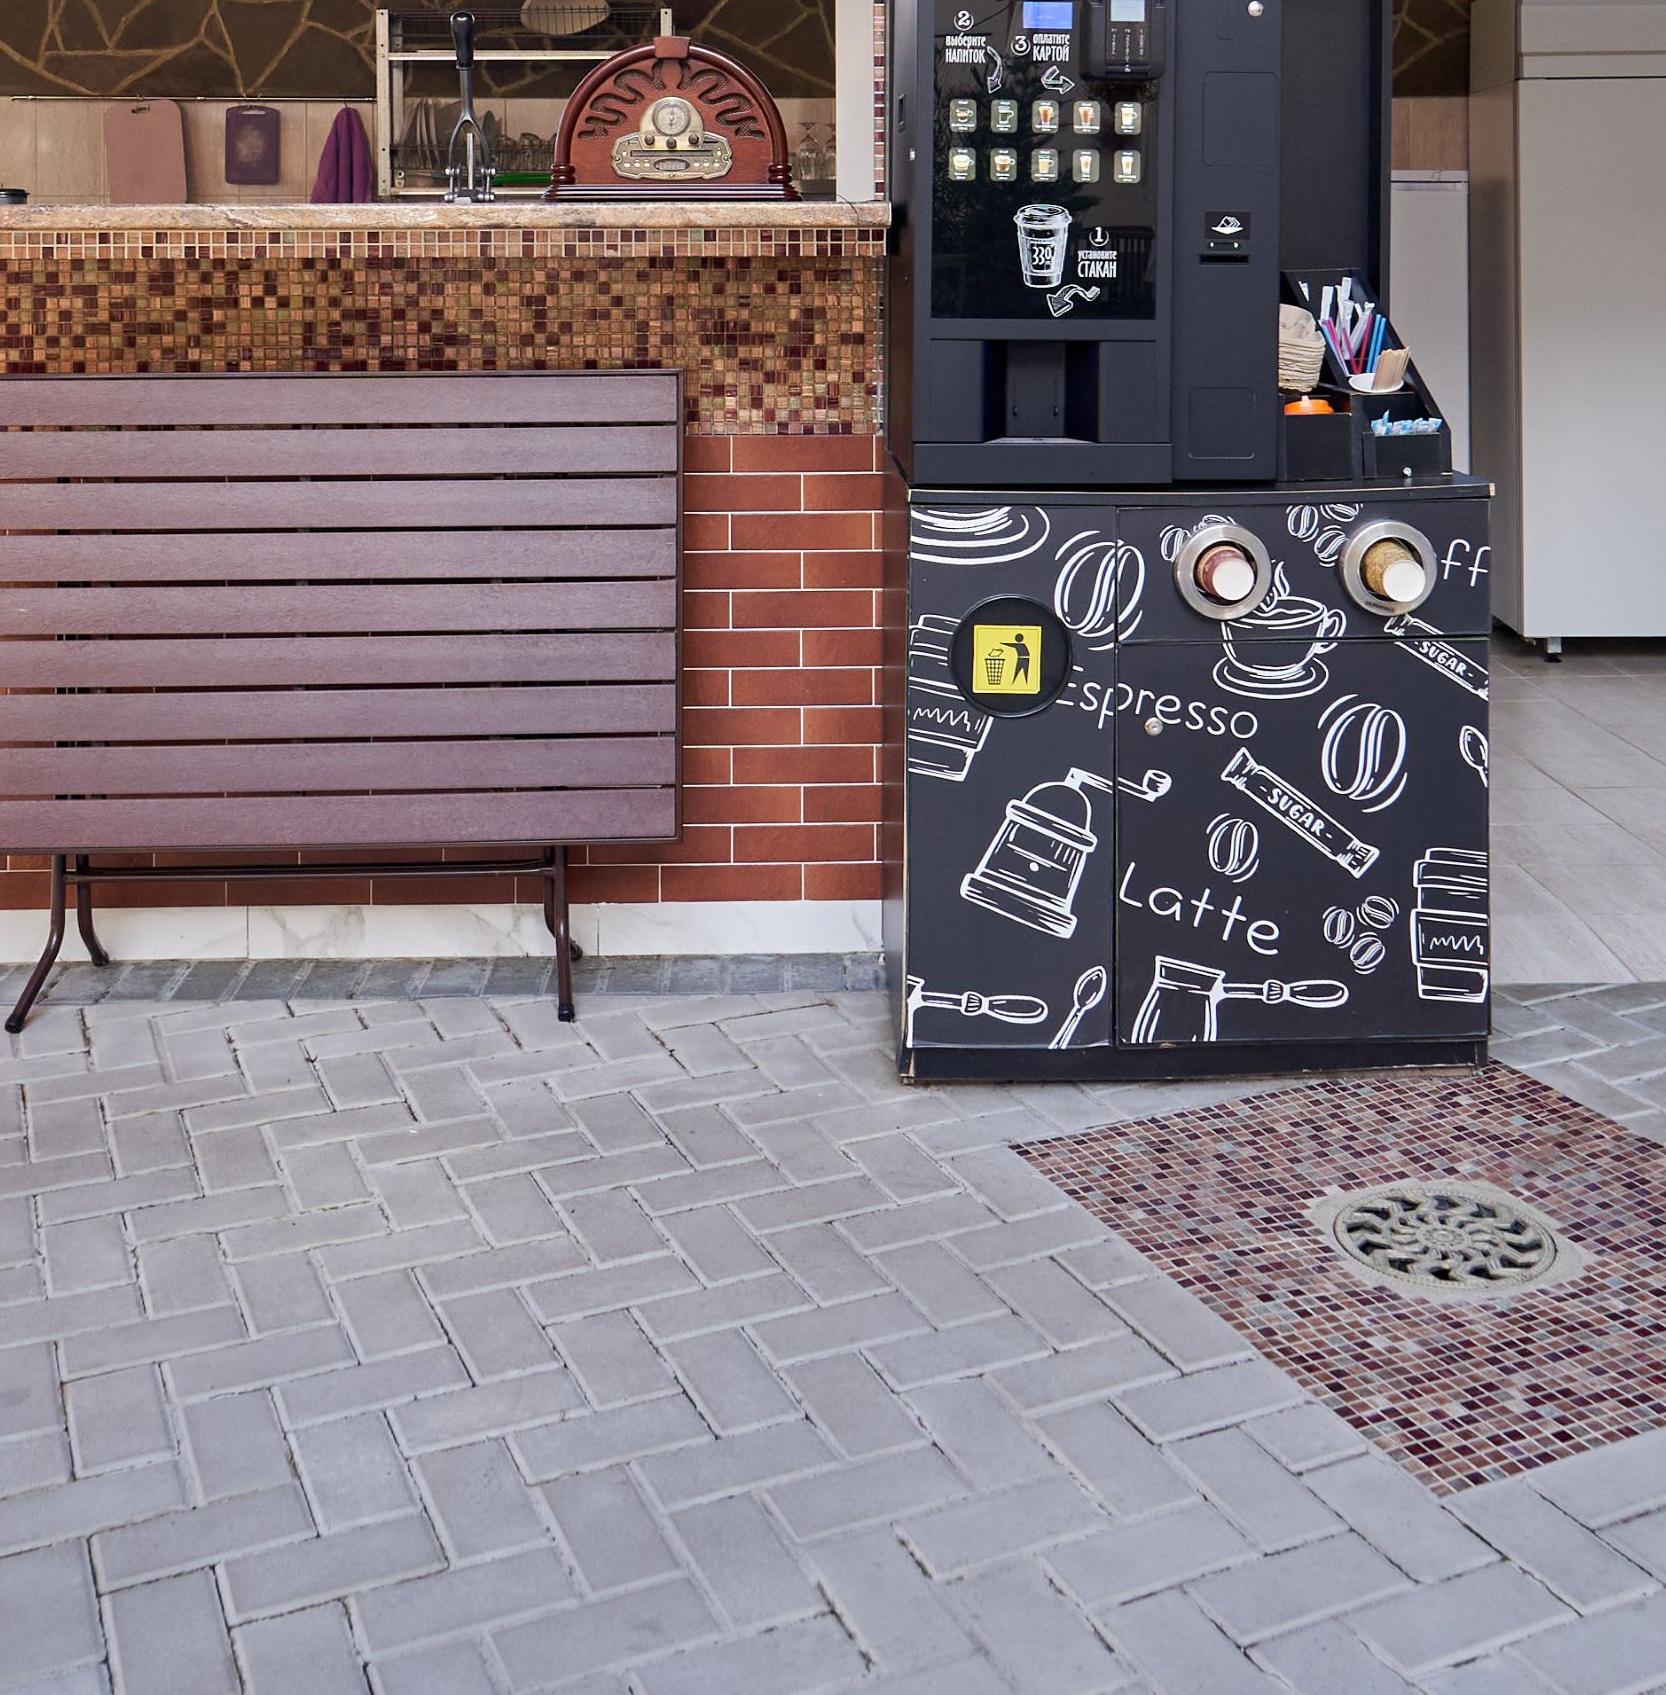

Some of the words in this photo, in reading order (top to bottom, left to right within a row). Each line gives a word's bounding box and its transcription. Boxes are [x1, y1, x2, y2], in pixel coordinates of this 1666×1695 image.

[945, 33, 986, 47] выберите
[1033, 33, 1070, 45] оплатите
[945, 48, 986, 63] НАПИТОК
[1033, 44, 1069, 62] КАРТОЙ
[1078, 250, 1117, 261] установите
[1078, 260, 1117, 278] СТАКАН
[1418, 640, 1467, 676] SUGAR
[1267, 787, 1326, 837] SUGAR
[1119, 861, 1280, 955] Latte
